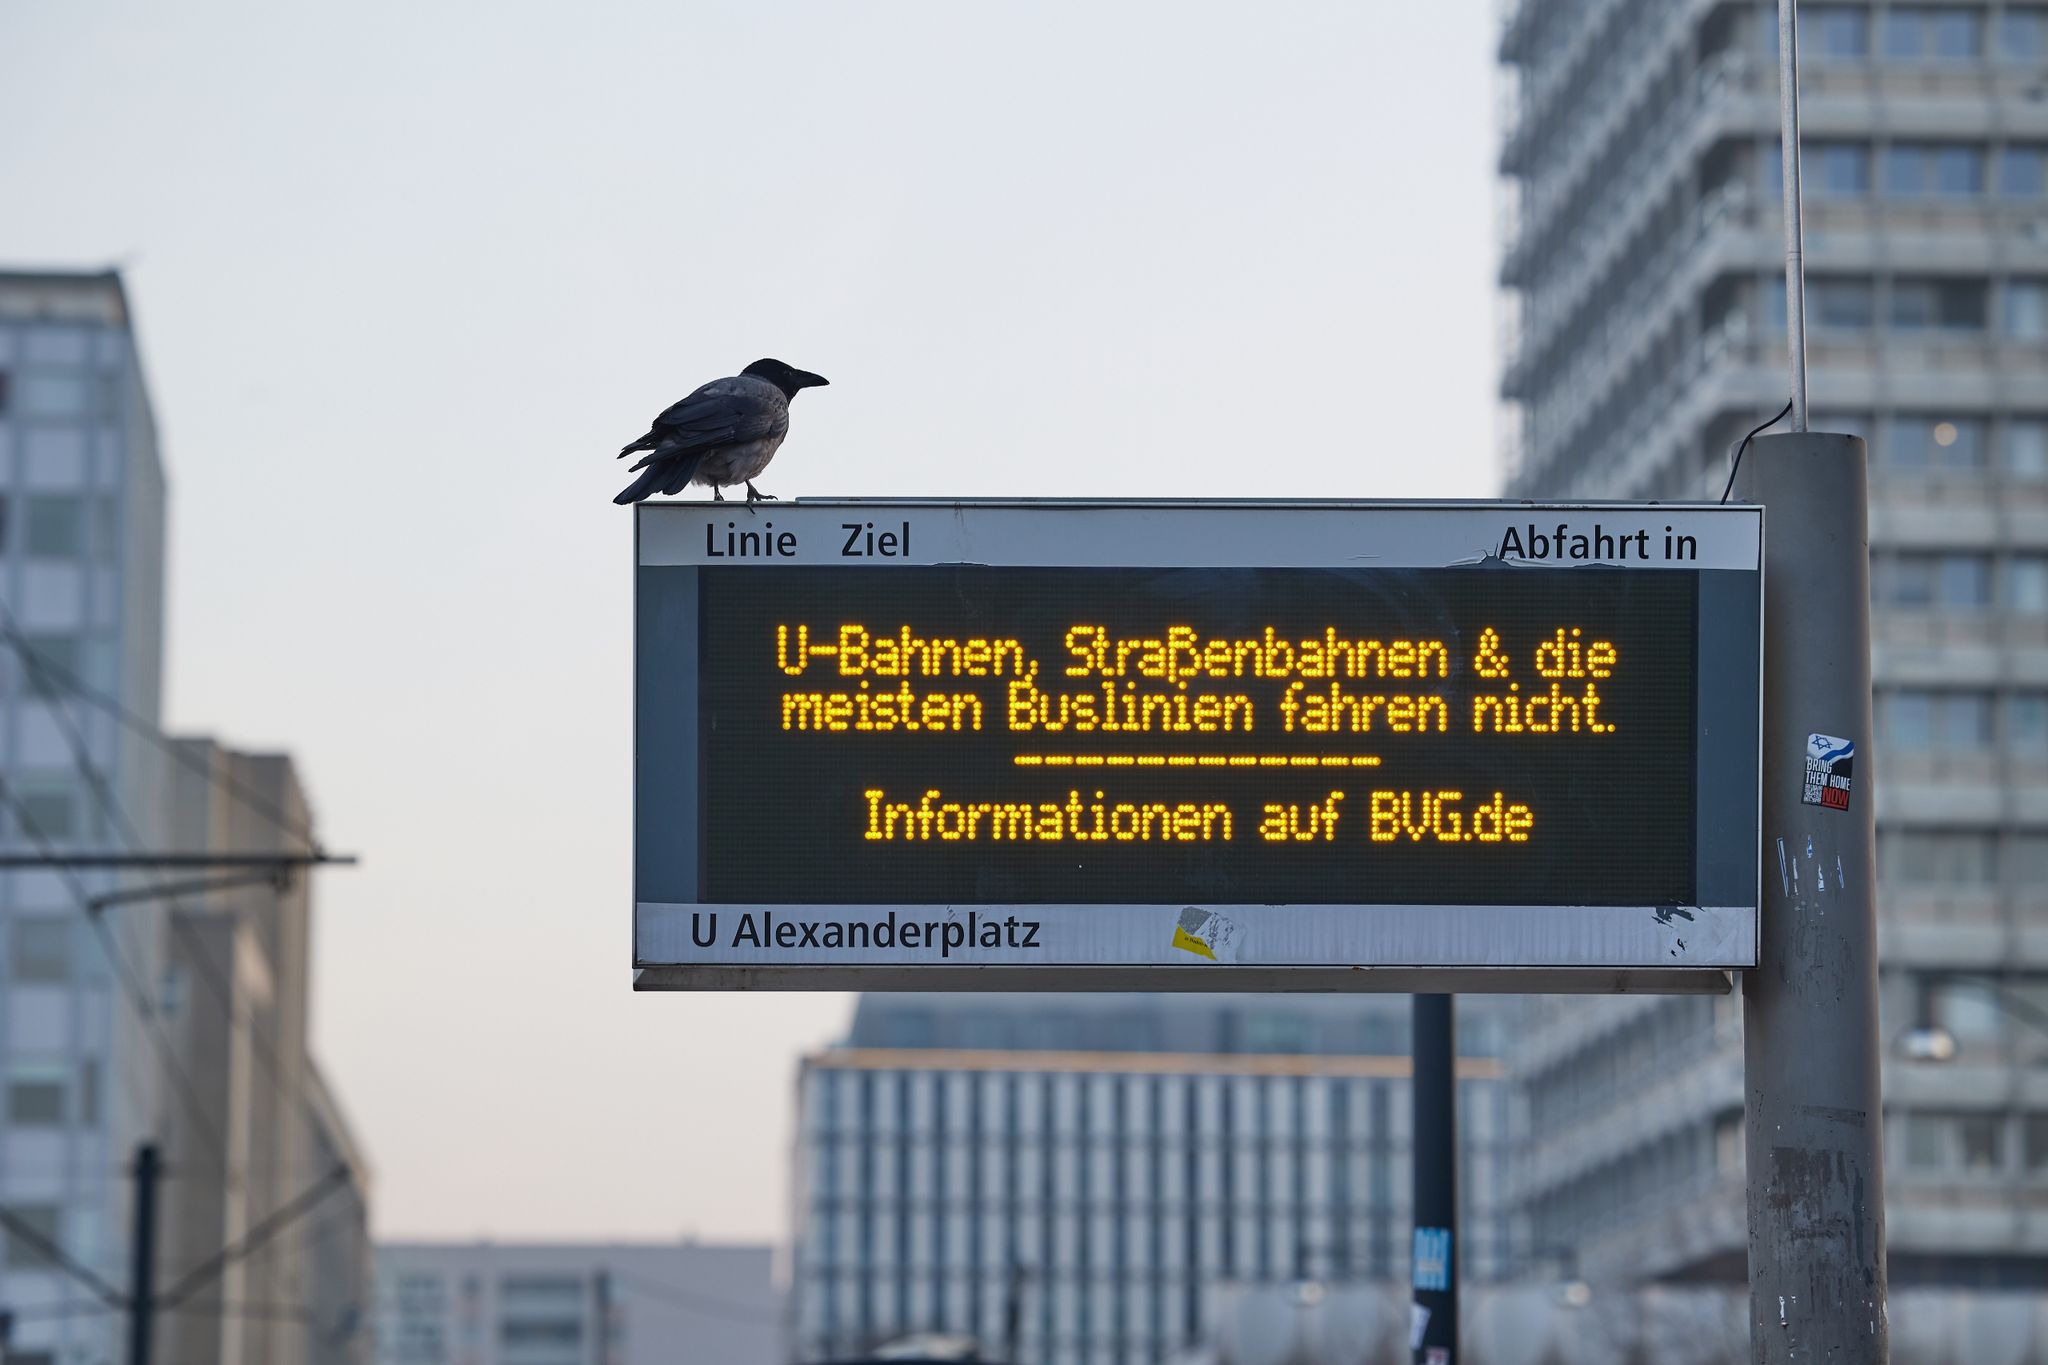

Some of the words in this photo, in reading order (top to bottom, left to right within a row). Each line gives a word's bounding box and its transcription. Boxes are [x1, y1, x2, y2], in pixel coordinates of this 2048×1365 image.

[706, 521, 797, 557] Linie
[841, 521, 910, 557] Ziel
[1499, 523, 1650, 560] Abfahrt
[1665, 525, 1697, 561] in
[776, 623, 1040, 682] U-Bahnen,
[1064, 624, 1449, 683] Straßenbahnen
[1473, 627, 1510, 679] &
[1535, 627, 1617, 679] die
[780, 681, 983, 732] meisten
[1007, 680, 1254, 732] Buslinien
[1279, 681, 1448, 733] fahren
[1471, 682, 1616, 734] nicht.
[1806, 757, 1832, 773] BRING
[1806, 770, 1828, 786] THEM
[1829, 774, 1851, 791] HOME
[864, 788, 1233, 842] Informationen
[1258, 790, 1345, 842] auf
[1369, 790, 1534, 843] BVG.de
[1823, 788, 1849, 805] NOW
[692, 913, 717, 948] U
[731, 909, 1040, 958] Alexanderplatz
